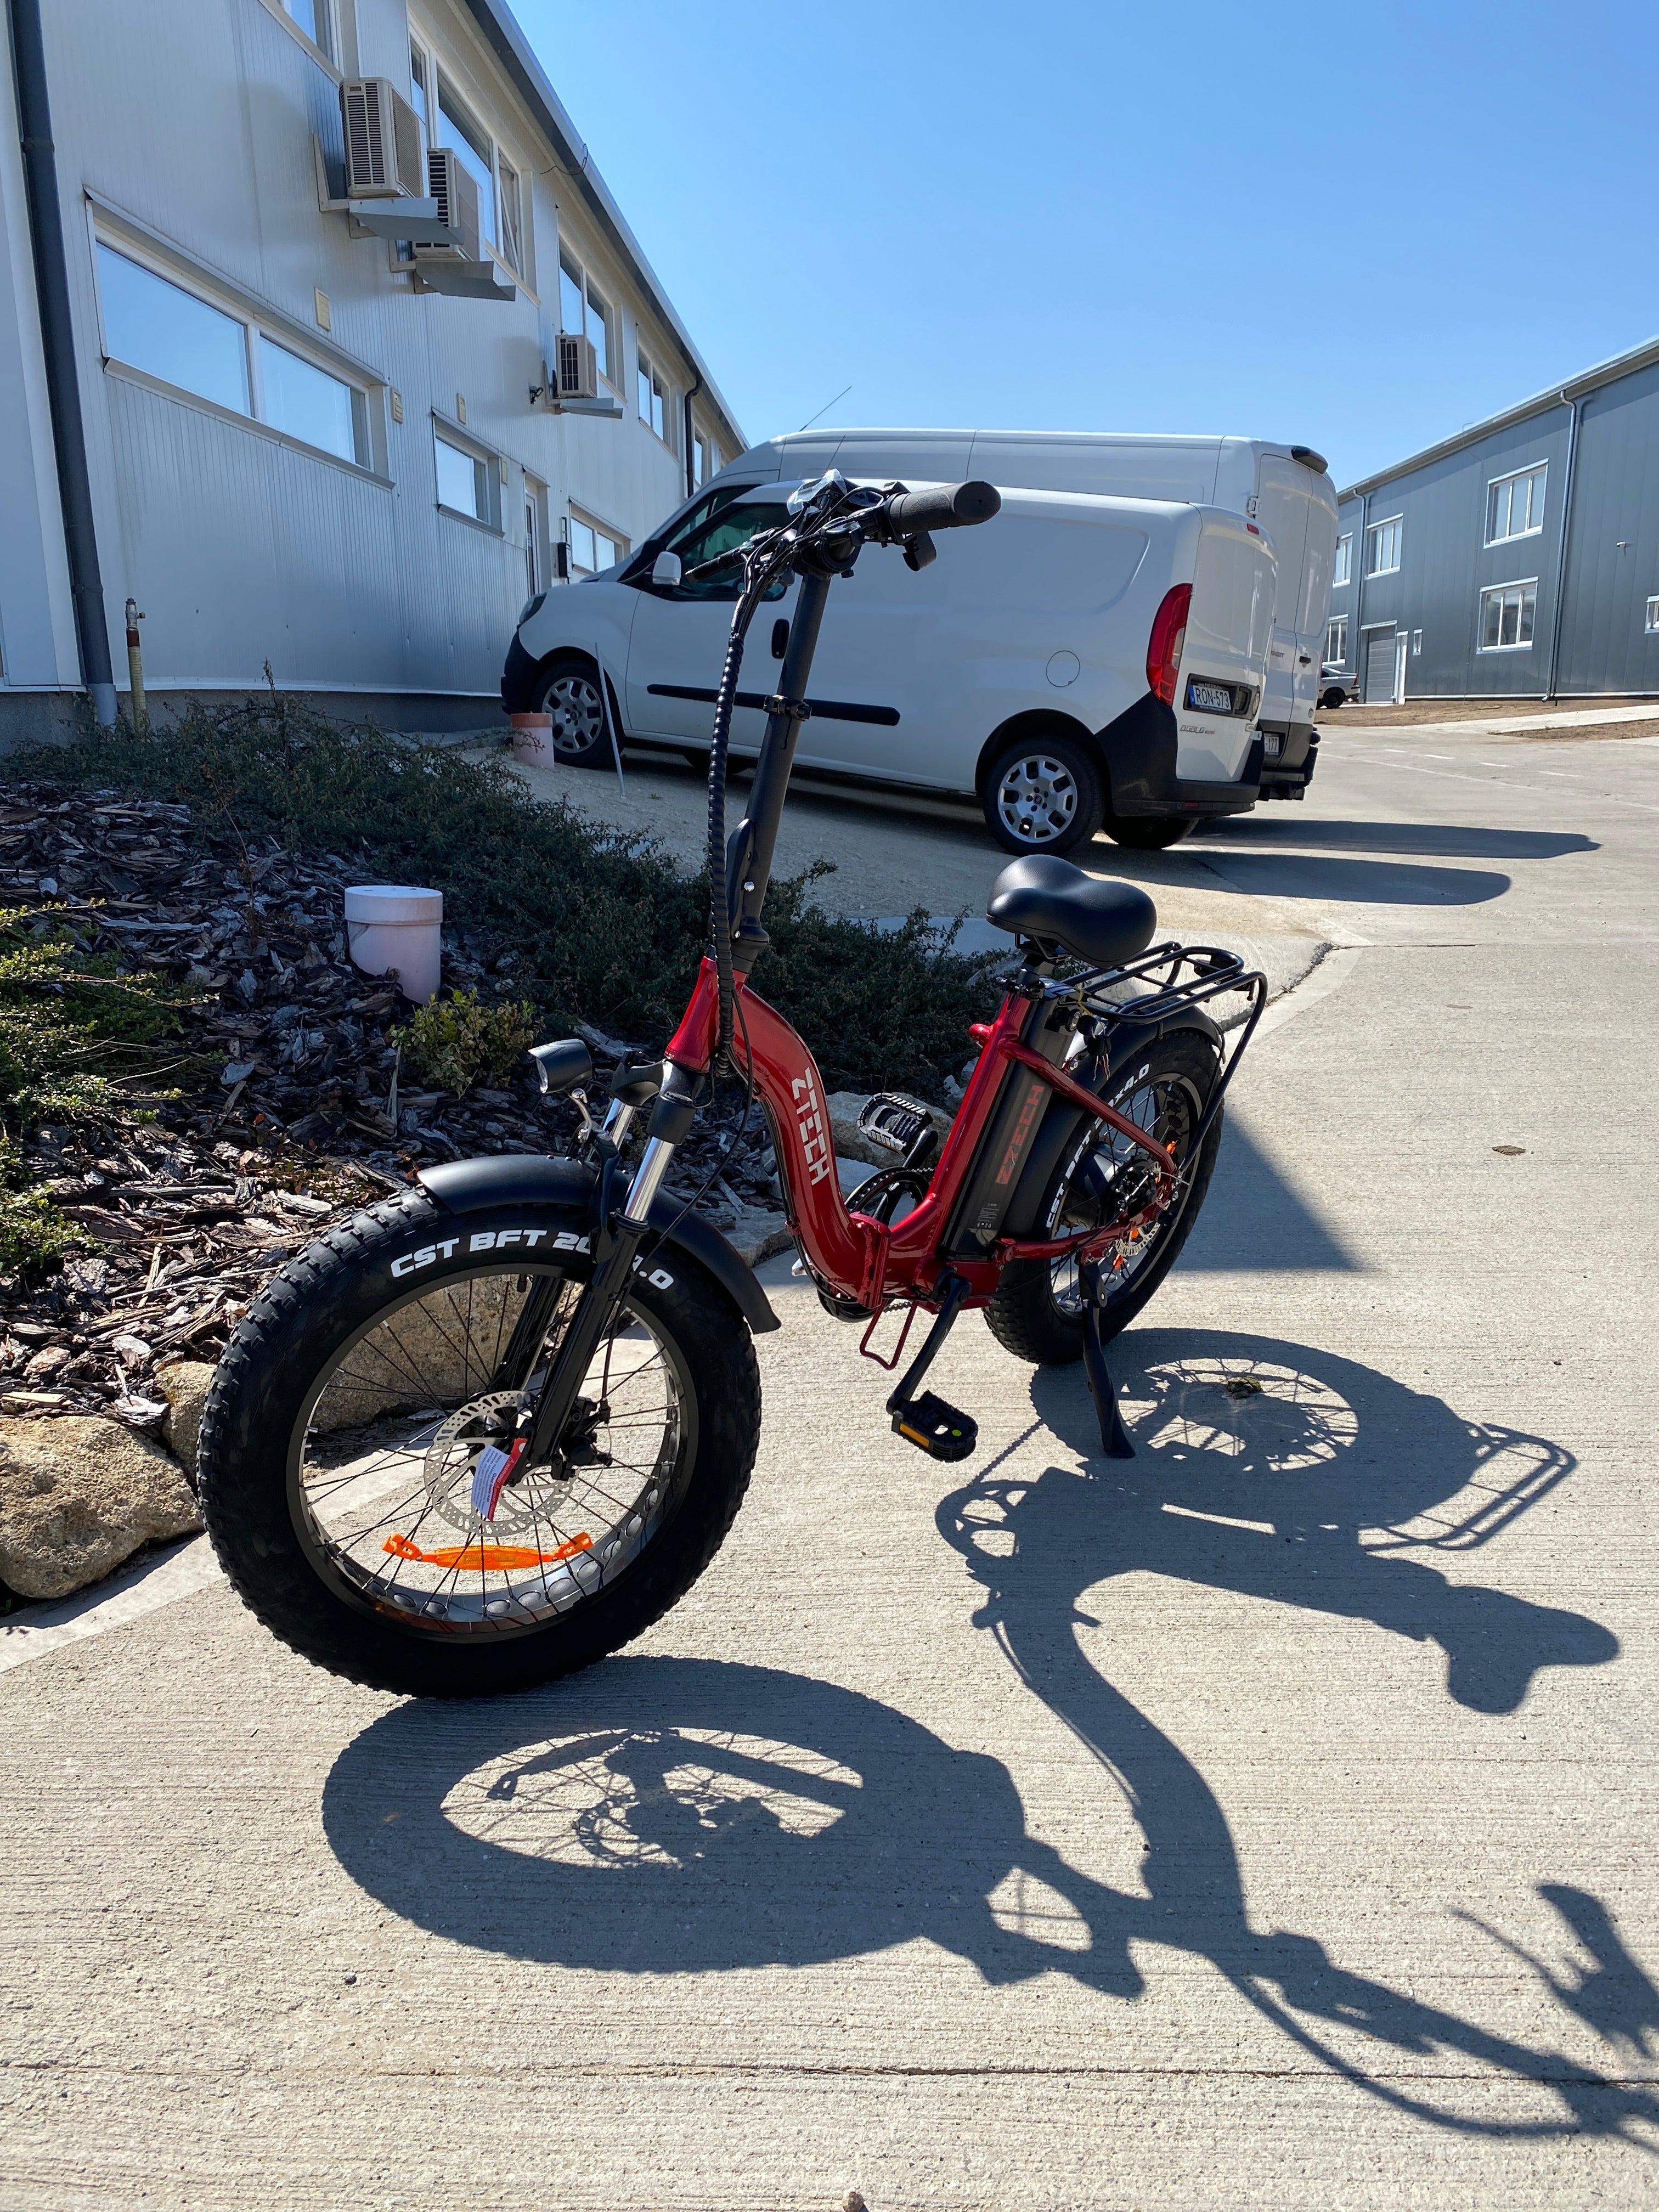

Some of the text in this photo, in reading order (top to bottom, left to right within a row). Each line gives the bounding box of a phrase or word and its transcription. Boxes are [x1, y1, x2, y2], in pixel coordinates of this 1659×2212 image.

[1195, 687, 1229, 708] RON-573
[792, 1067, 830, 1186] ZTECH
[996, 1084, 1045, 1184] ZTECH
[1046, 1182, 1064, 1228] CST
[1065, 1130, 1091, 1179] BFT
[390, 1238, 460, 1278] CST
[469, 1229, 547, 1252] BFT
